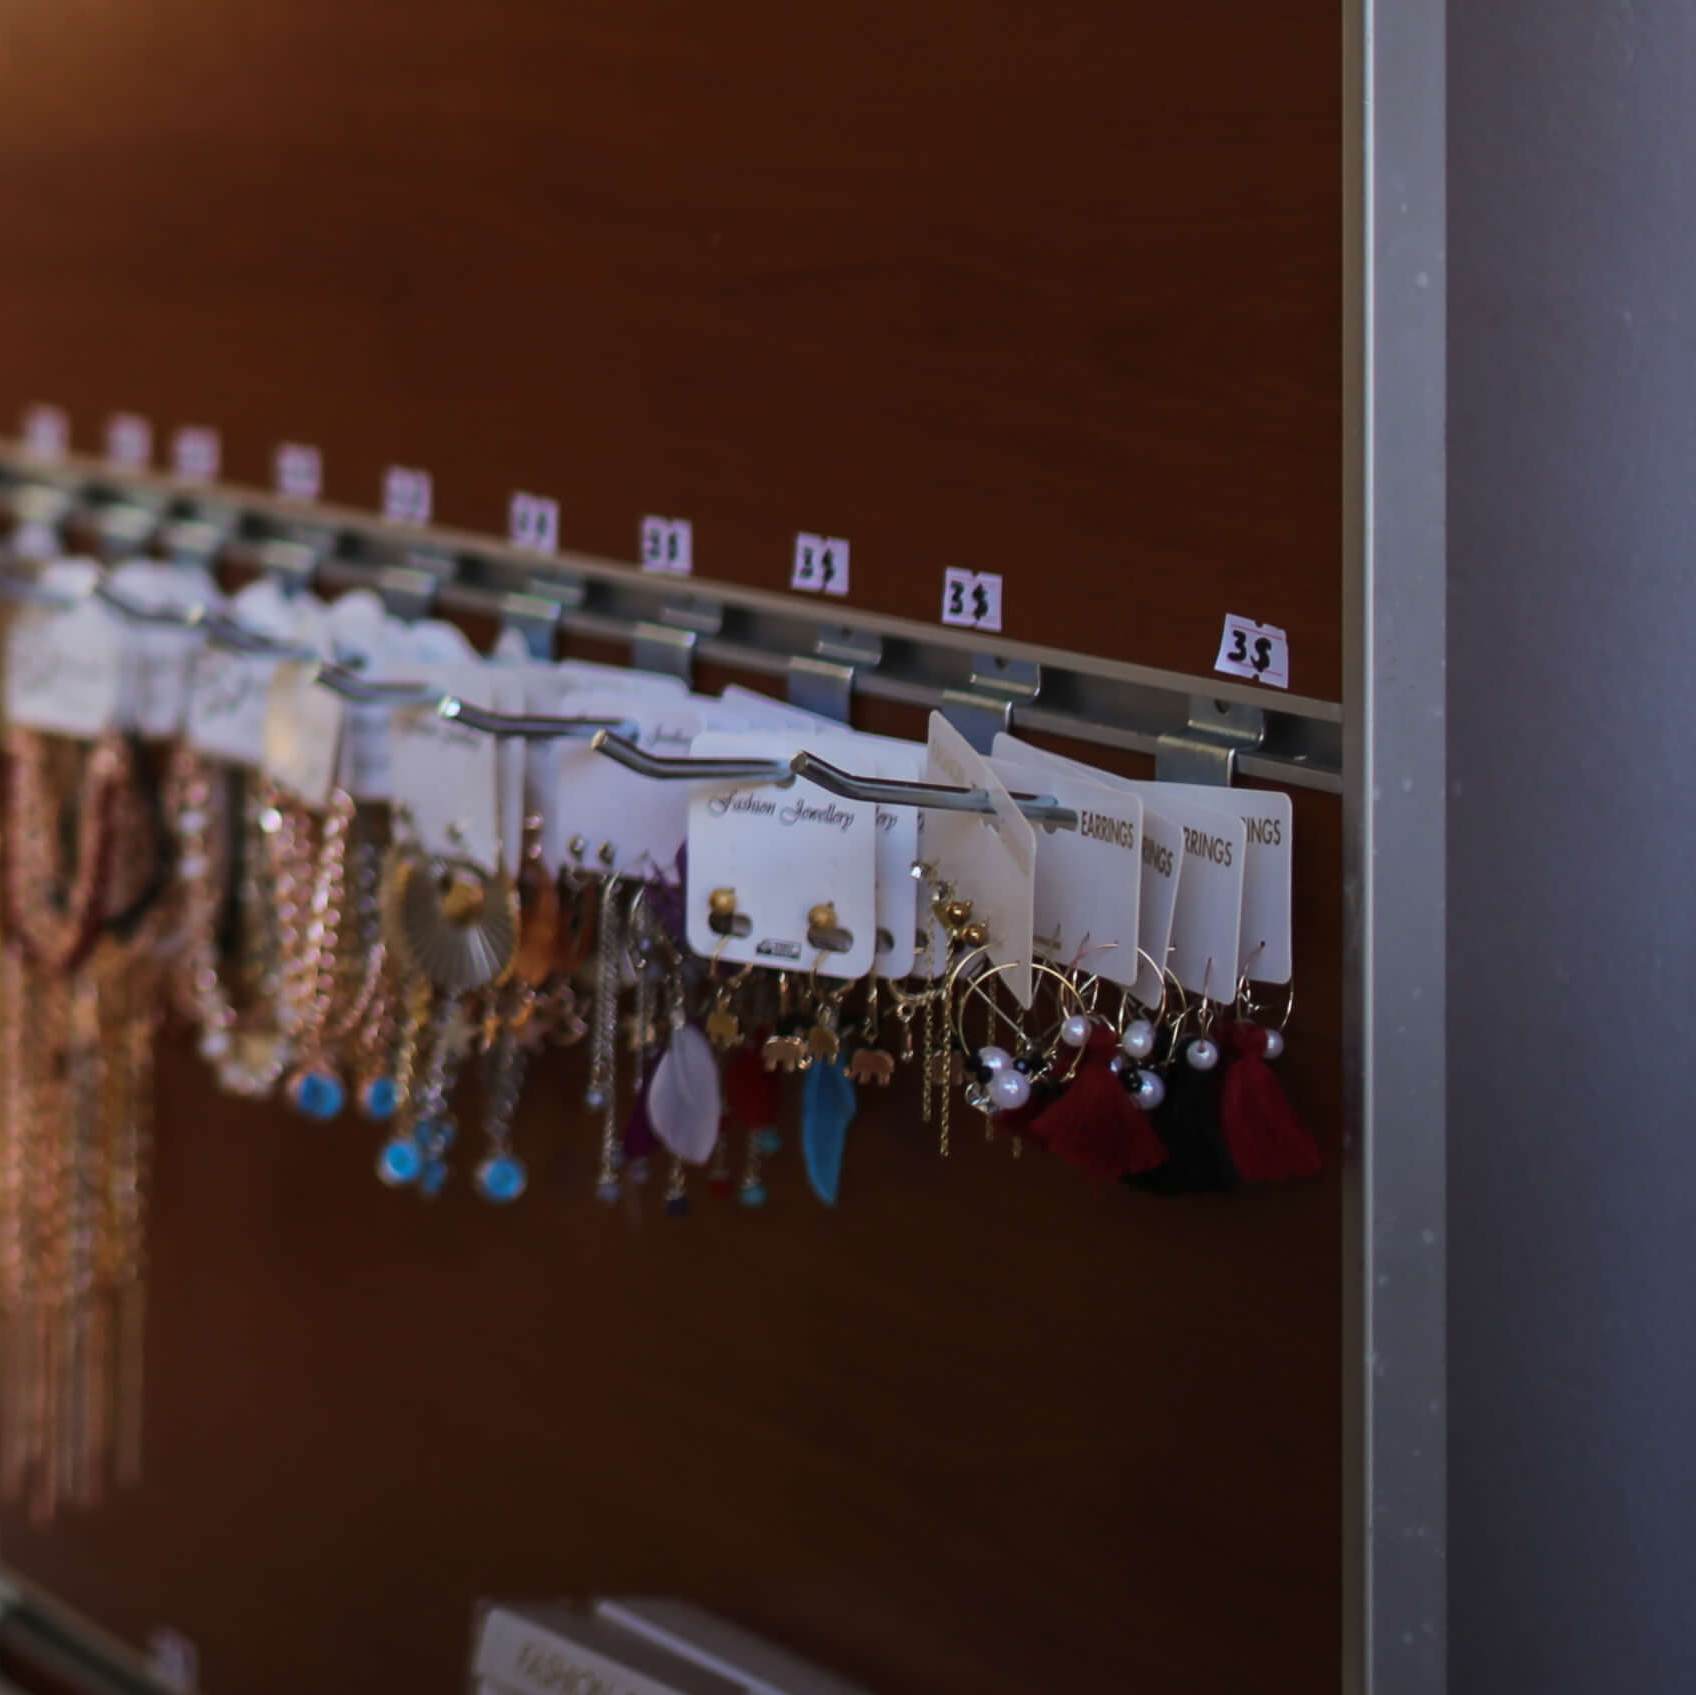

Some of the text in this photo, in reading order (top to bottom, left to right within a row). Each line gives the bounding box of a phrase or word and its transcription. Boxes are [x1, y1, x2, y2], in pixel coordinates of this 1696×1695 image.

[1080, 810, 1134, 850] EARRINGS
[1183, 825, 1233, 867] RRINGS
[1245, 816, 1282, 846] INGS
